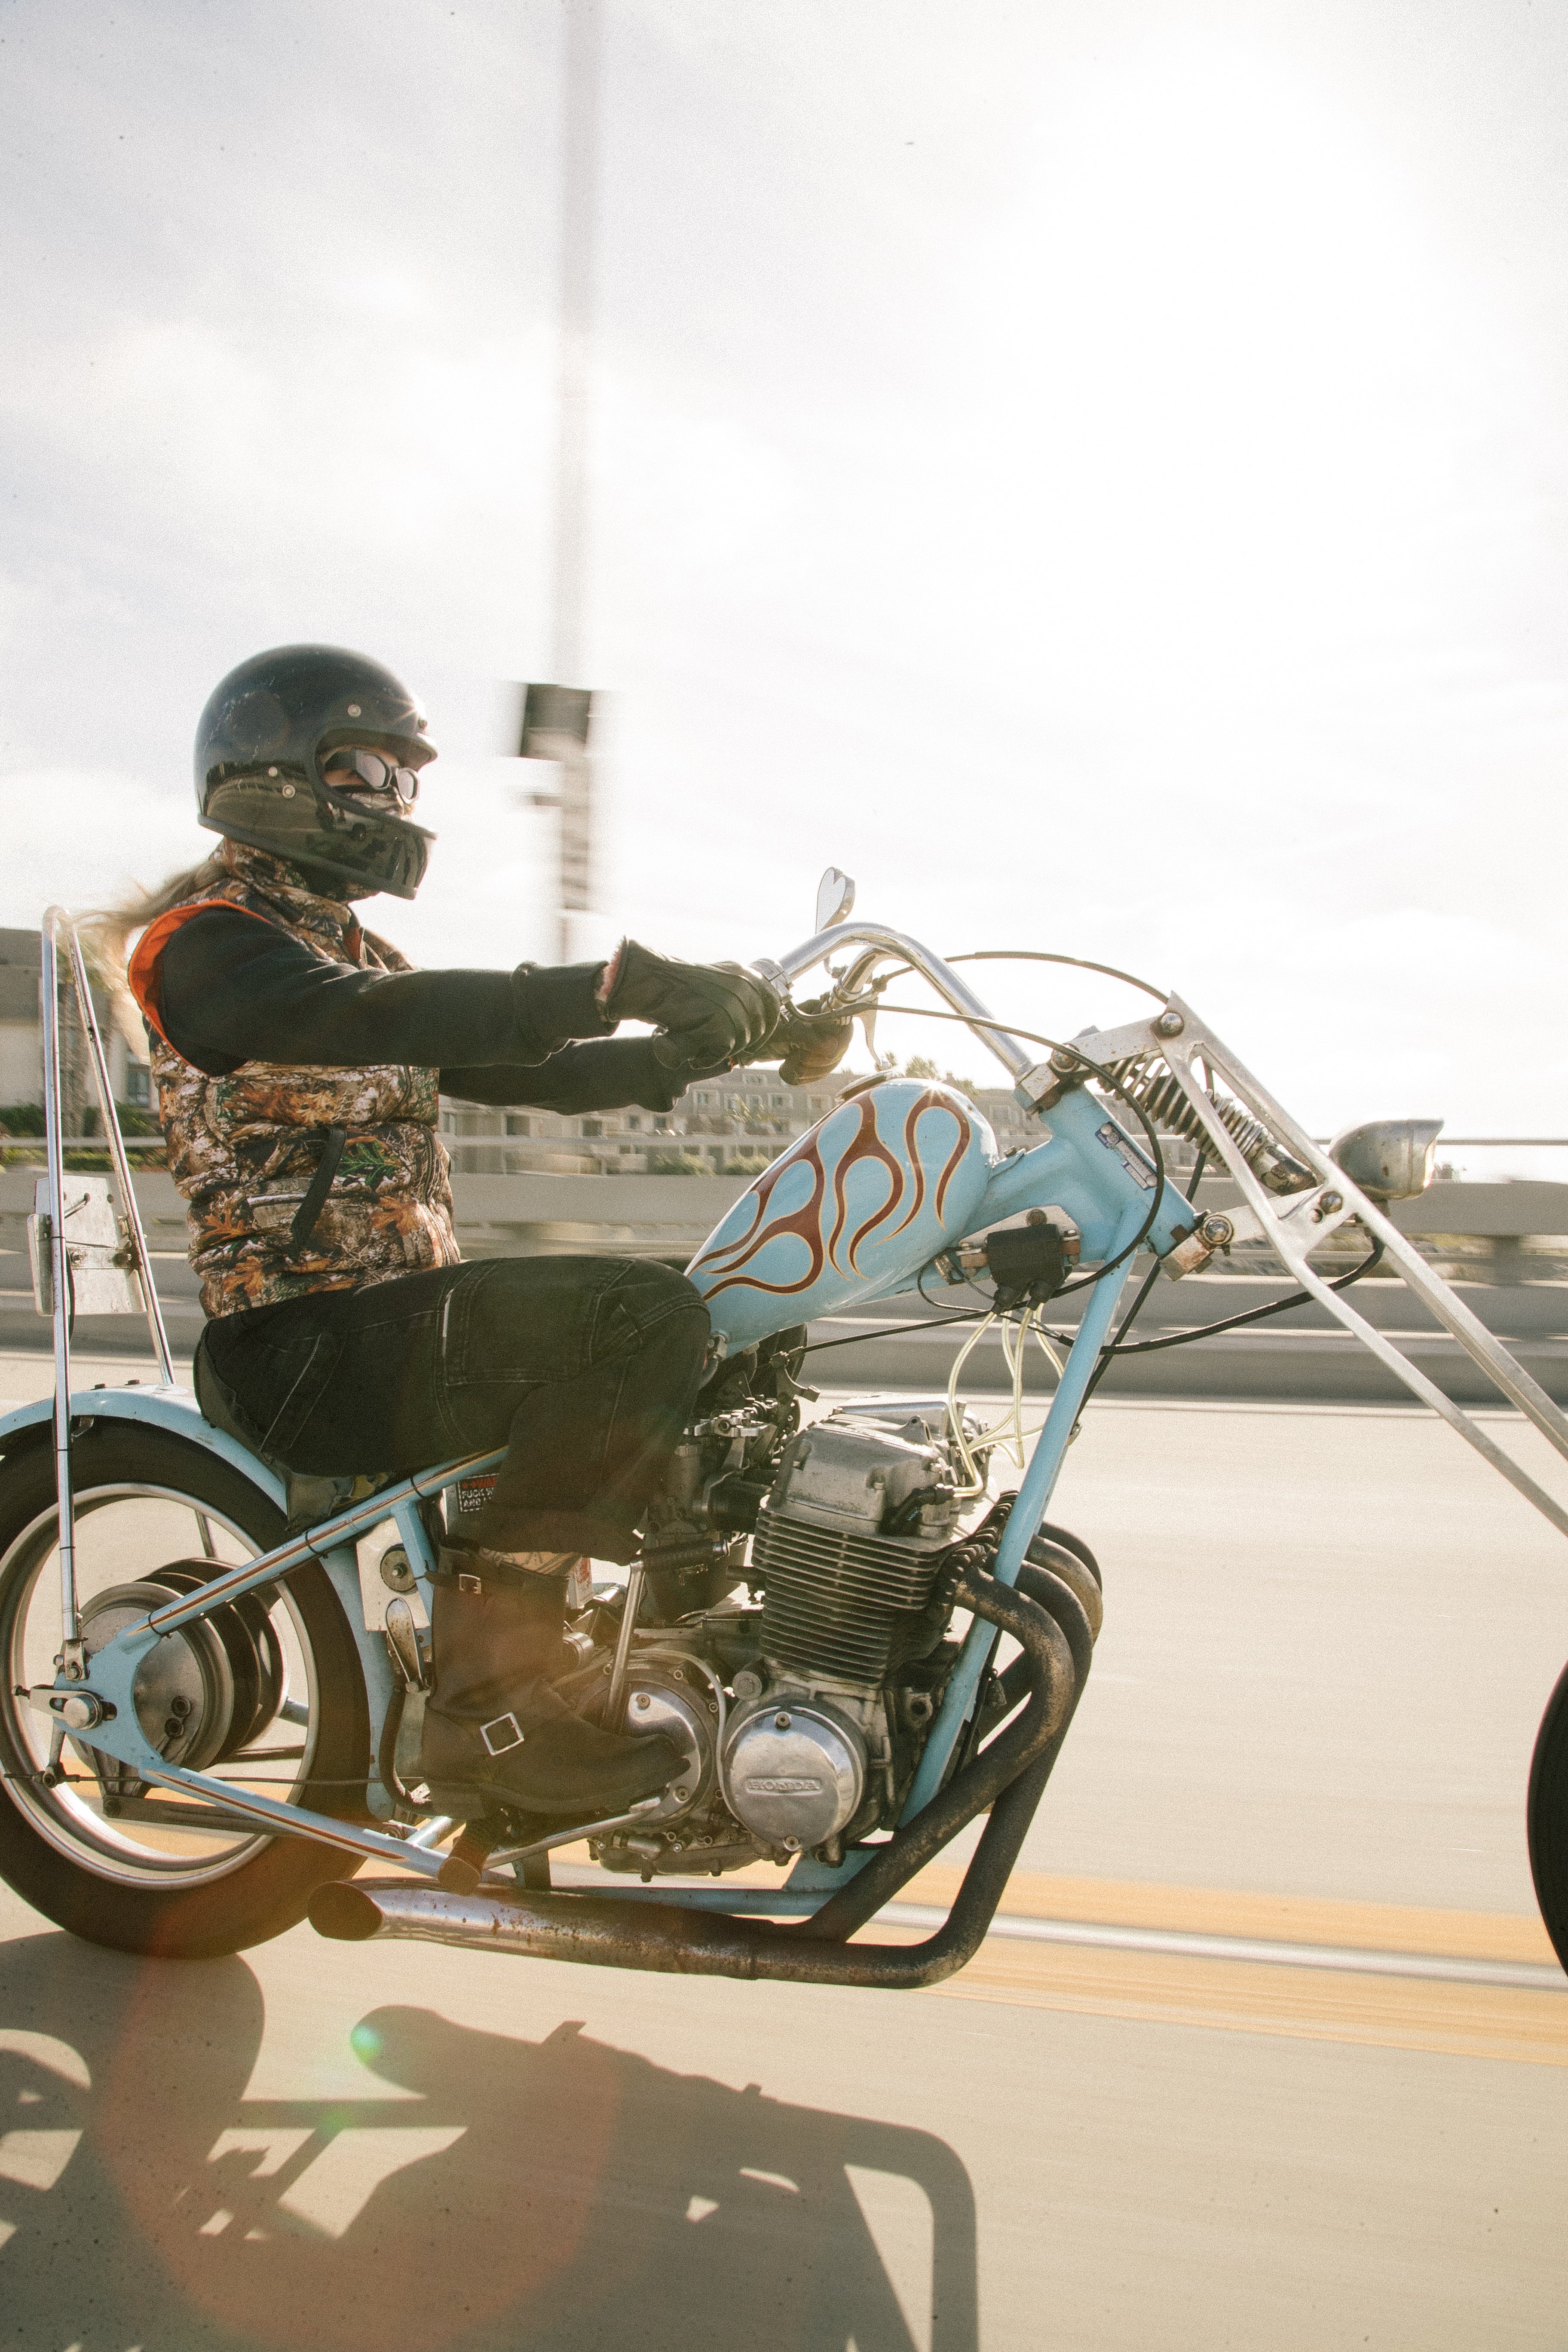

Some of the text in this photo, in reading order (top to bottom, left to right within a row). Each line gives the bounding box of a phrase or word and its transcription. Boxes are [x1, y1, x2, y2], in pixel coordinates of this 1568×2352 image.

[462, 1488, 484, 1499] FUCK
[463, 1498, 481, 1507] AND
[748, 1779, 820, 1791] HONDA
